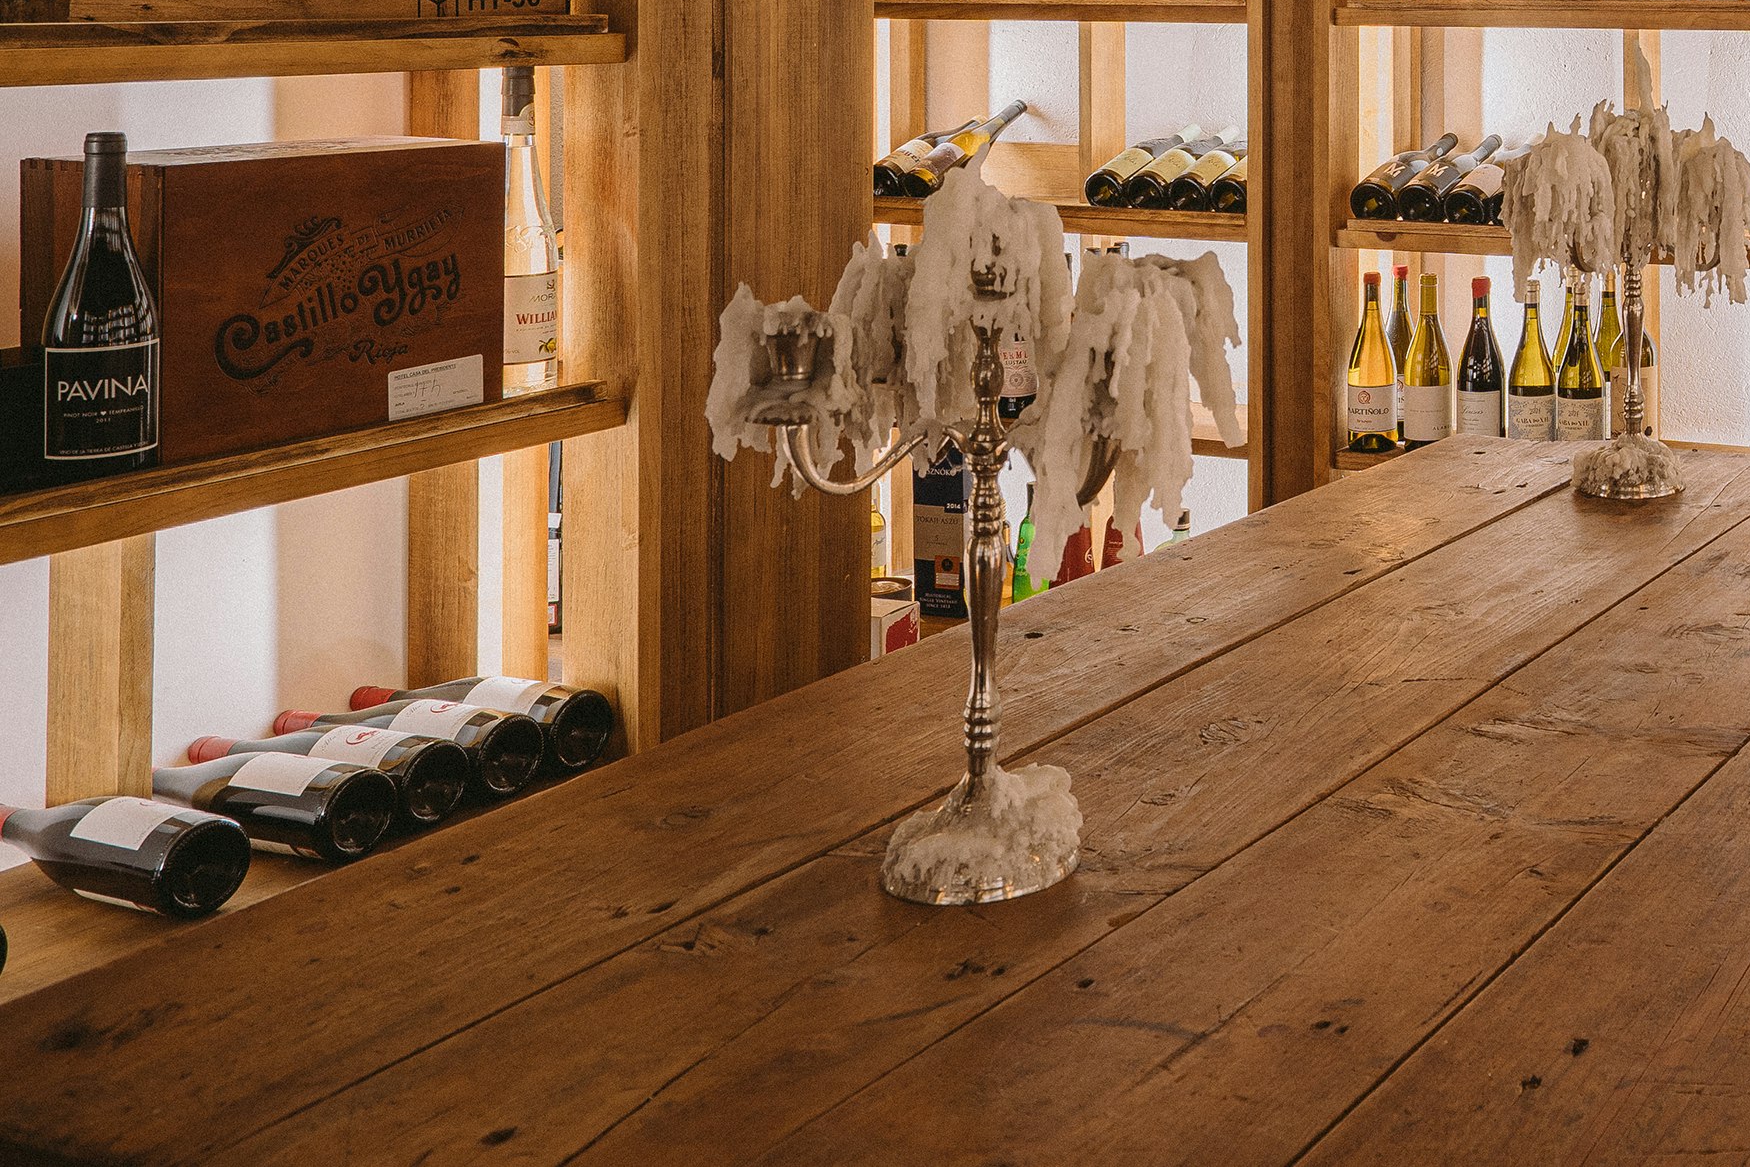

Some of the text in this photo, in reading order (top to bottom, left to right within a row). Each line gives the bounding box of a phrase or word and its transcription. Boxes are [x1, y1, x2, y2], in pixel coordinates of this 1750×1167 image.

[383, 207, 451, 251] MURRIETA
[214, 252, 462, 381] Castillo Ygay
[349, 338, 409, 365] Rioja
[57, 374, 149, 402] PAVINA
[108, 404, 144, 415] TEMPRANILLO
